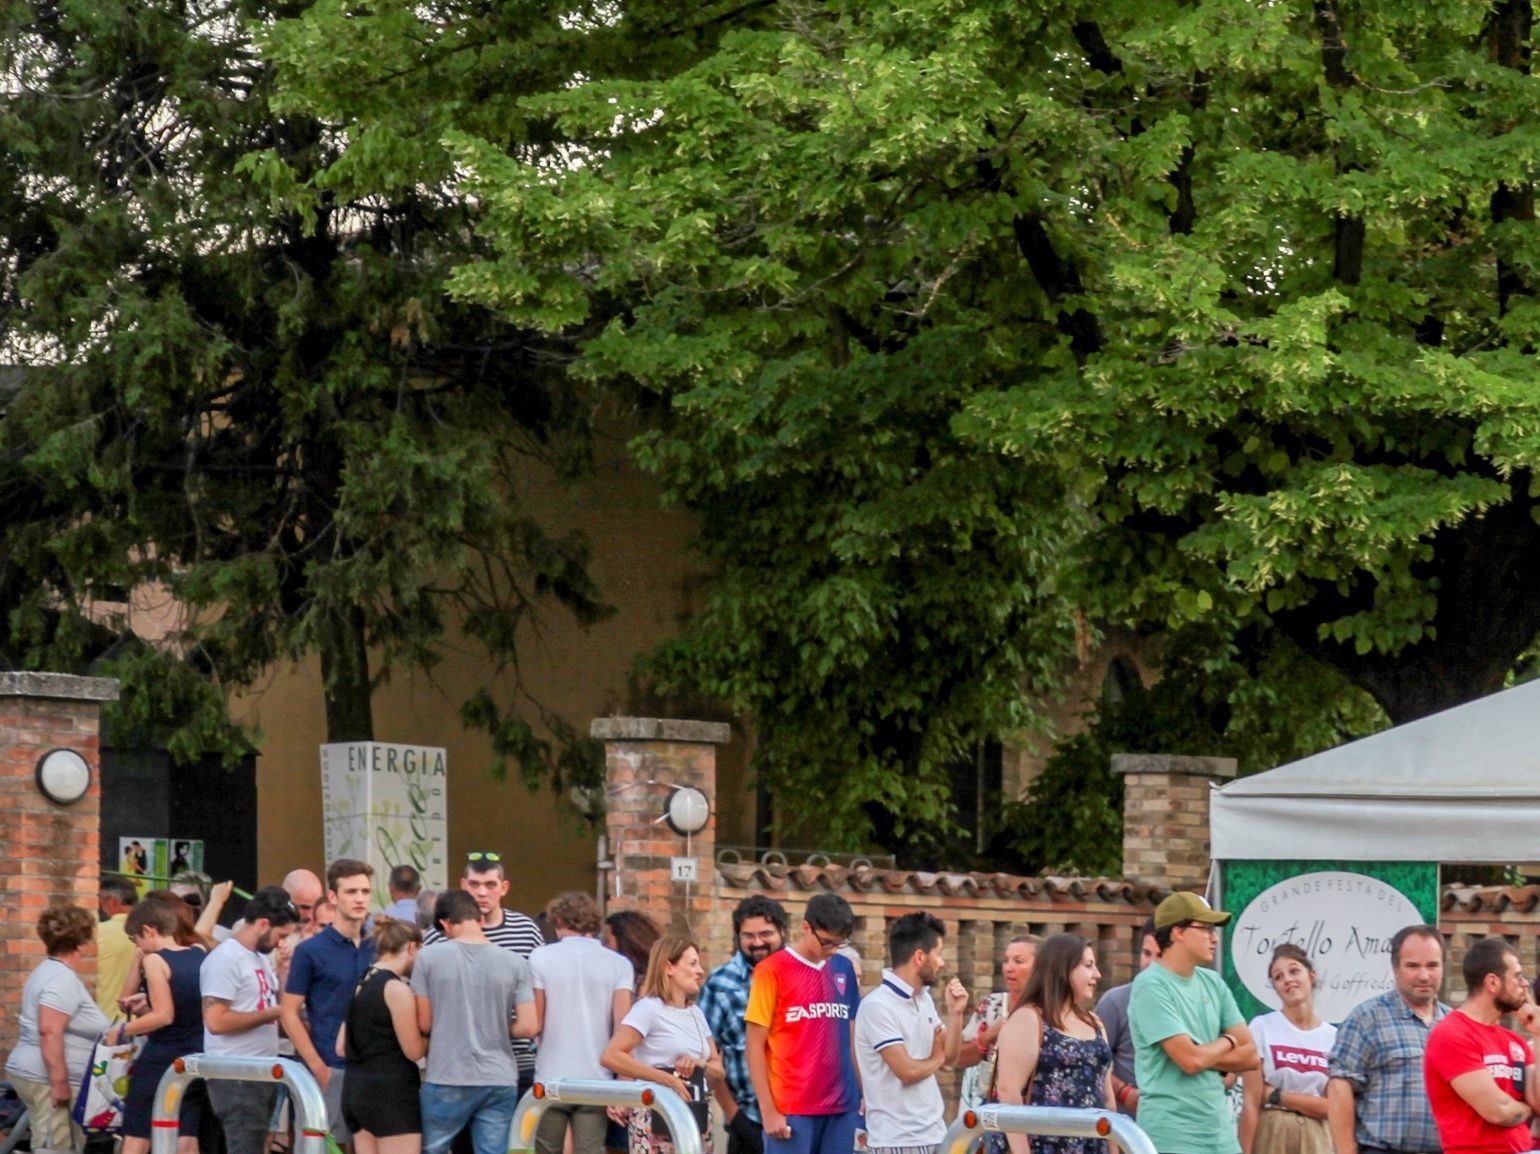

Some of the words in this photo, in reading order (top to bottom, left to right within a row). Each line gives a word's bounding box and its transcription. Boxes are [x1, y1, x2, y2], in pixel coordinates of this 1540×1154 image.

[348, 746, 446, 777] ENERGIA
[678, 865, 692, 877] 17
[1260, 880, 1321, 913] GRANDE
[1327, 879, 1373, 894] FESTA
[1377, 888, 1403, 913] DEL
[1345, 924, 1393, 959] Ama
[785, 1005, 810, 1022] EA
